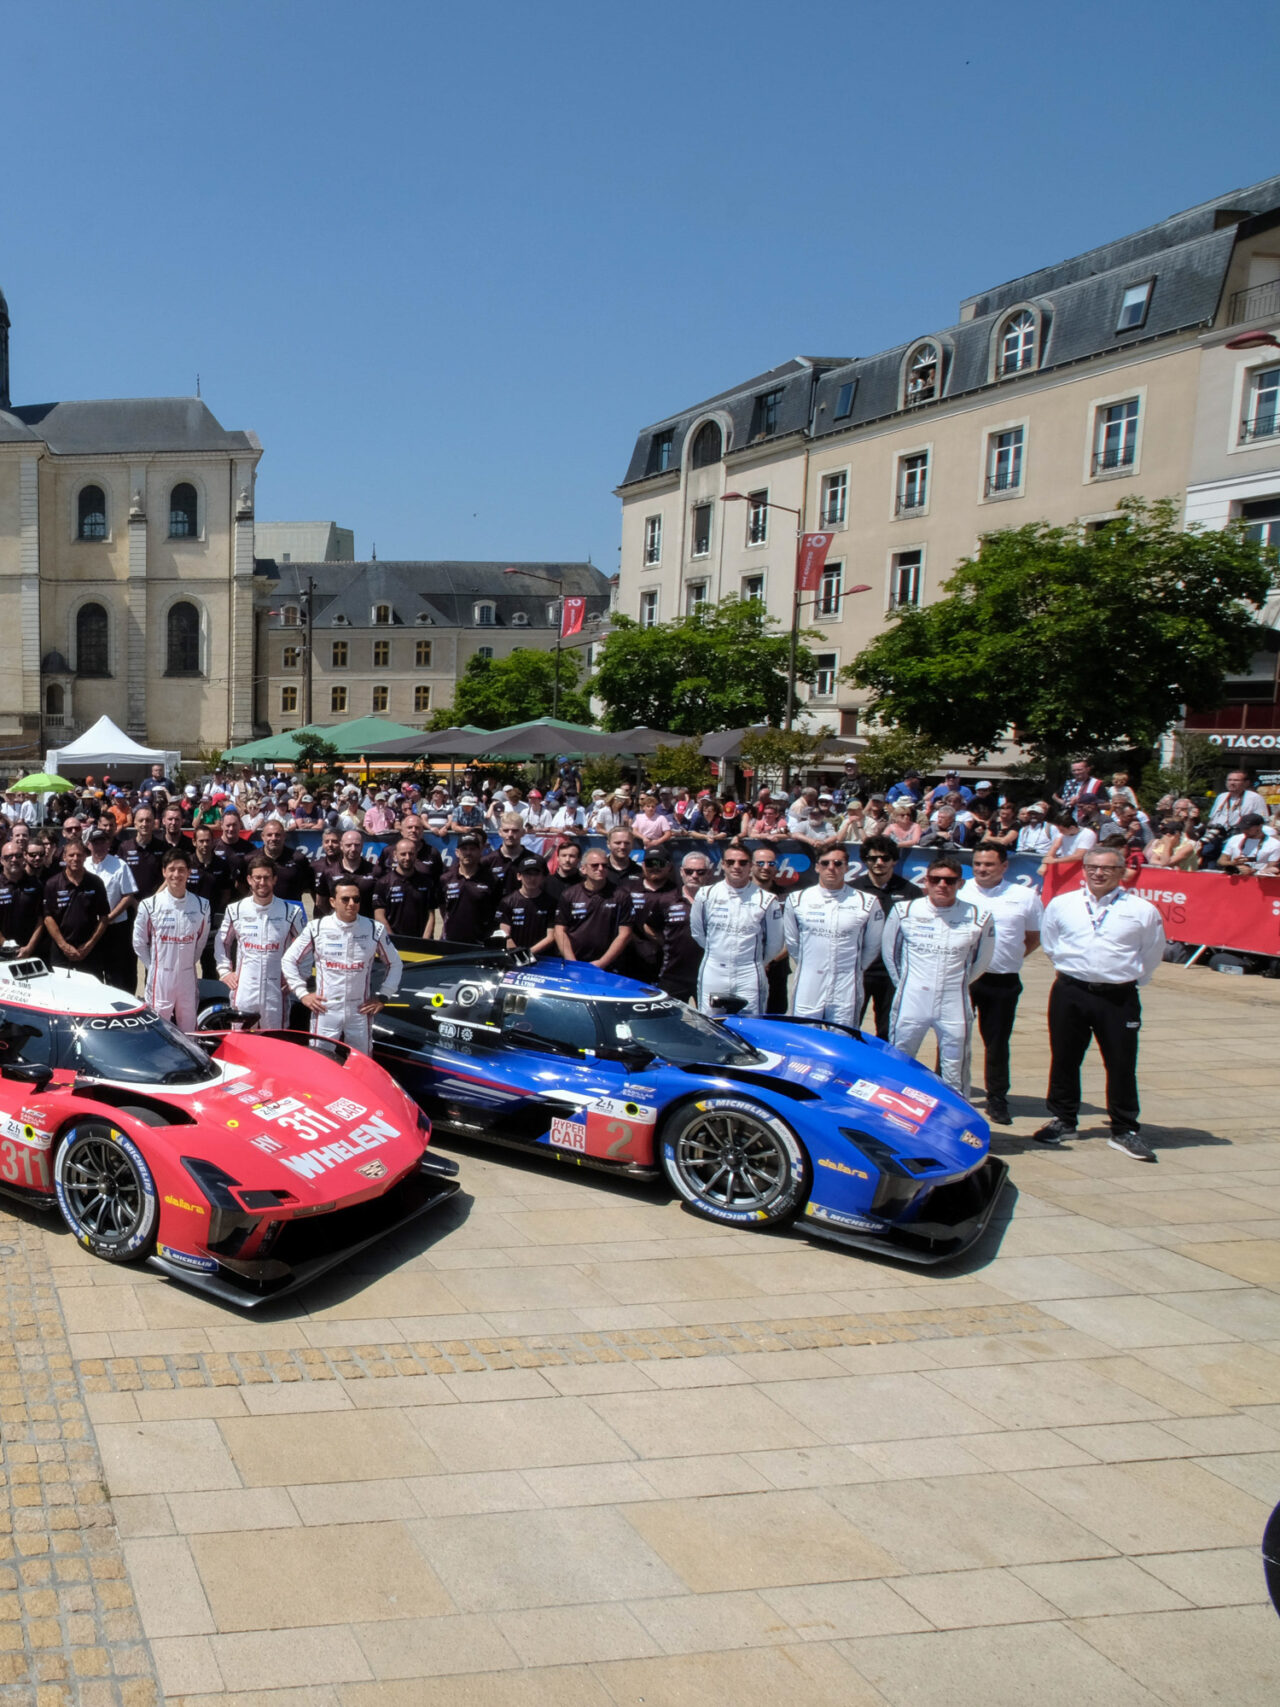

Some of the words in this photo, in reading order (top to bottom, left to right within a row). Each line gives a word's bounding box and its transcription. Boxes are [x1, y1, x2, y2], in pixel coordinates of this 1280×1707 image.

[1128, 888, 1187, 905] ourse
[244, 942, 280, 951] WHELEN
[326, 960, 365, 970] WHELEN
[91, 1014, 160, 1030] CADILL
[335, 1103, 364, 1119] CAR
[715, 1099, 770, 1120] MICHELIN
[877, 1093, 926, 1117] 2
[277, 1107, 341, 1140] 311
[553, 1119, 585, 1134] HYPER
[279, 1114, 401, 1180] WHELEN
[551, 1128, 585, 1149] CAR
[606, 1121, 634, 1160] 2
[1, 1141, 50, 1187] 311
[123, 1142, 153, 1191] MICHELIN
[818, 1158, 868, 1180] dallara
[56, 1184, 81, 1233] MICHELIN
[164, 1195, 205, 1215] dallara
[696, 1200, 748, 1221] MICHELIN
[830, 1213, 885, 1231] MICHELIN
[172, 1253, 213, 1267] MICHELIN
